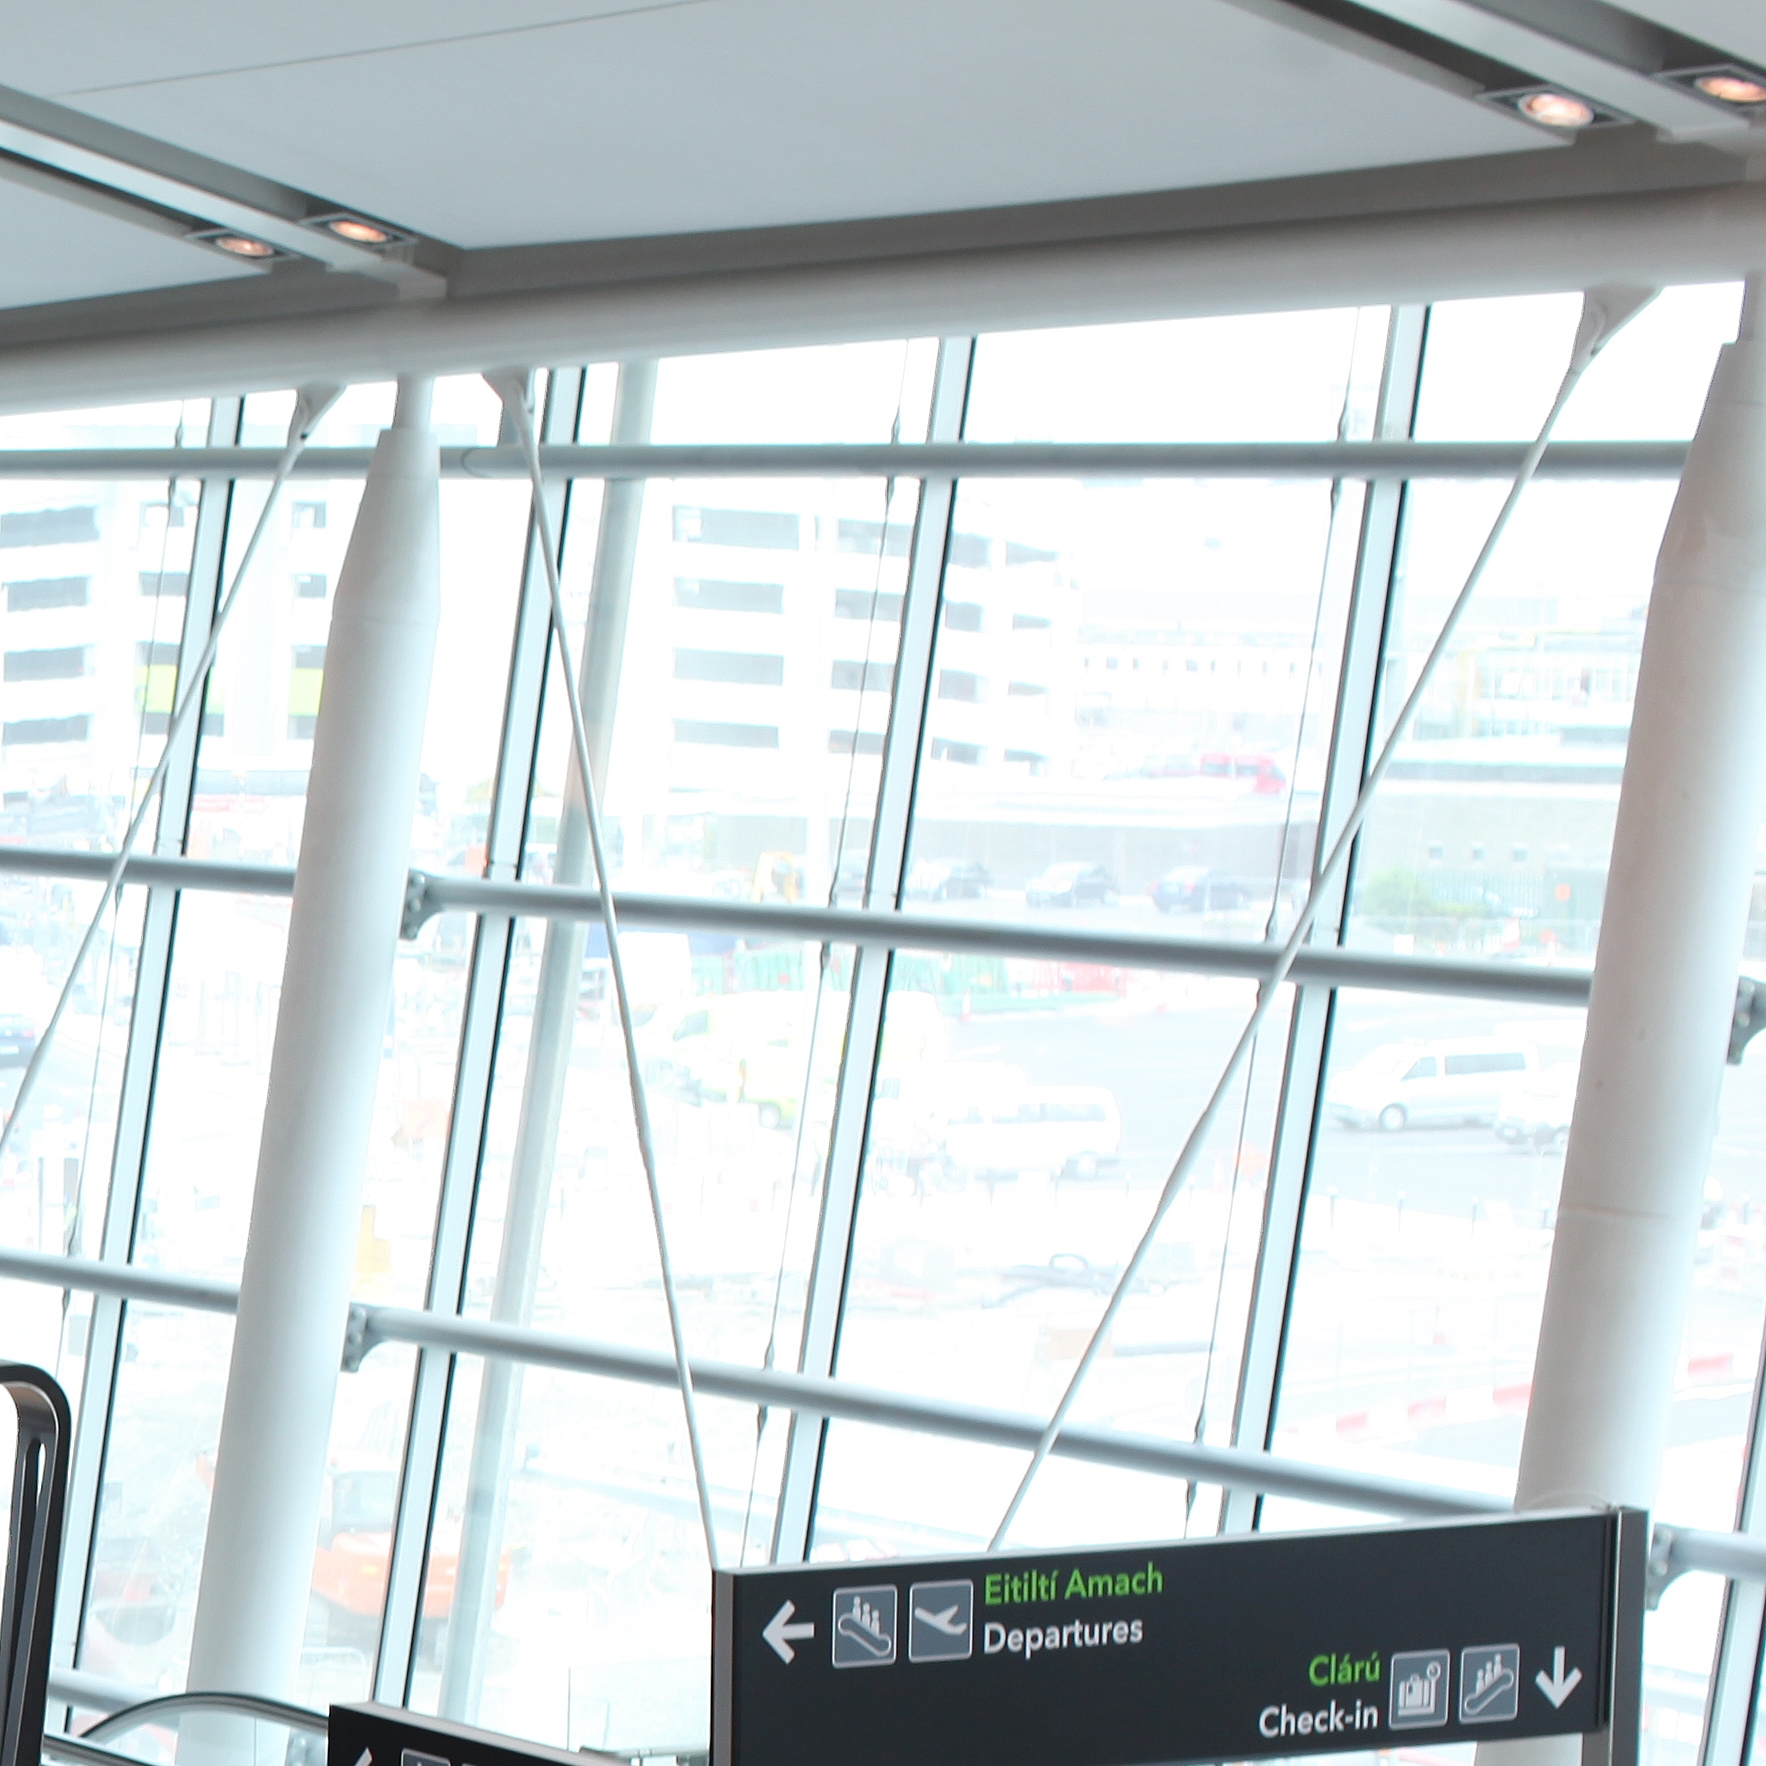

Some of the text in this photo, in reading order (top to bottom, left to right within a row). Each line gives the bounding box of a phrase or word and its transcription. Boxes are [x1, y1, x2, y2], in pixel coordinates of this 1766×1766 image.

[984, 1562, 1164, 1607] Eitiltí Amach
[983, 1619, 1143, 1658] Departures
[1308, 1652, 1382, 1687] Clárú
[1259, 1699, 1379, 1738] Check-in
